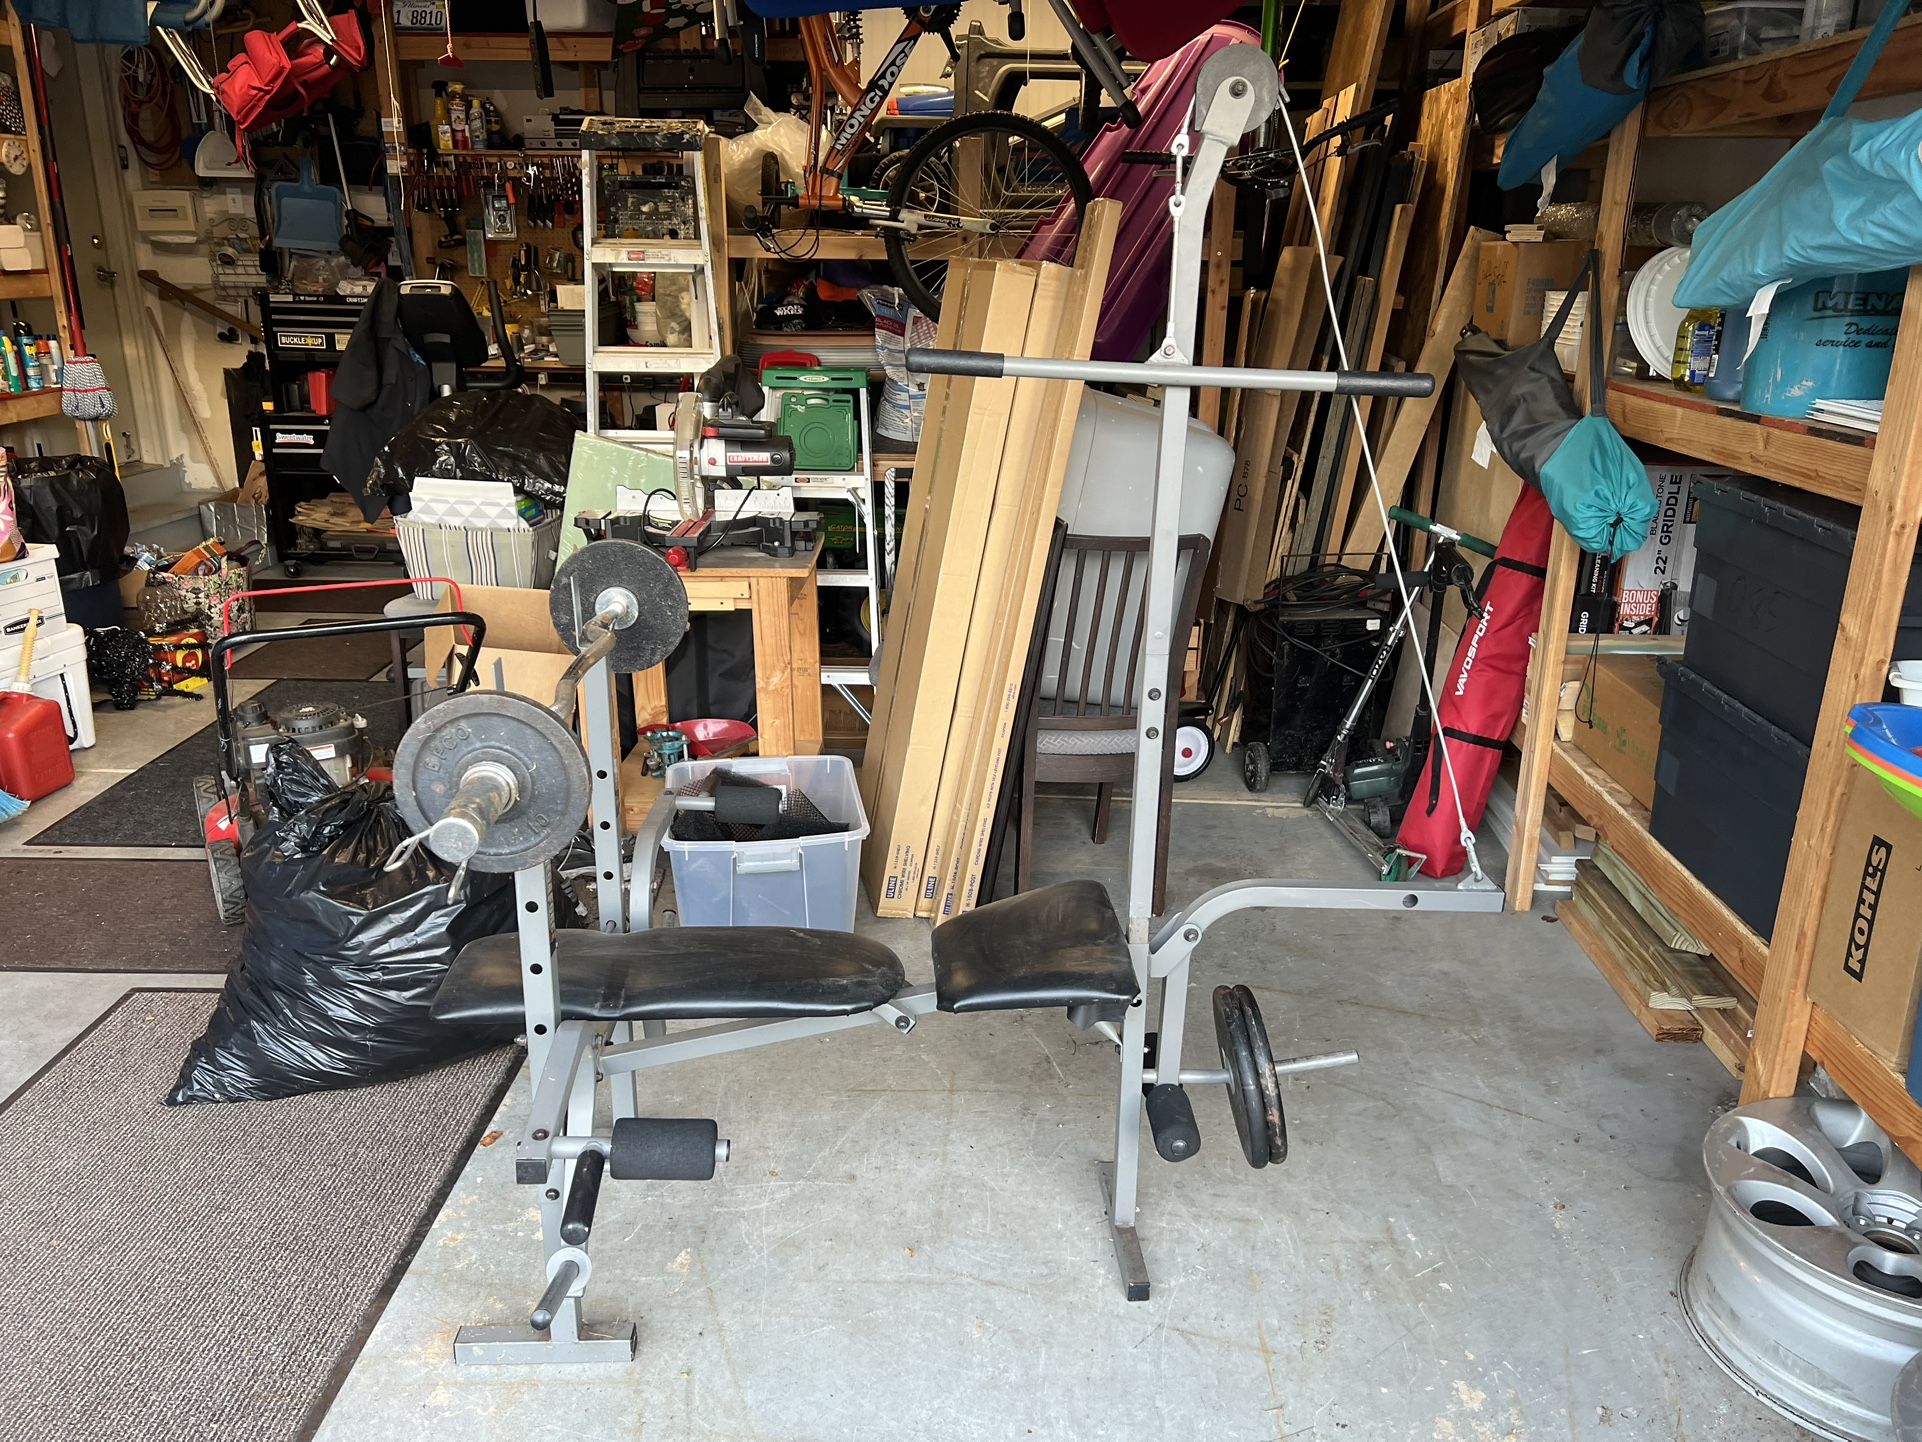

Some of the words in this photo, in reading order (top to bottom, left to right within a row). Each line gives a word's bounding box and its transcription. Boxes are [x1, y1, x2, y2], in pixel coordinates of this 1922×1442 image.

[411, 10, 443, 26] 8810
[1813, 290, 1905, 314] MENA
[281, 336, 306, 345] BUCKLE
[1816, 338, 1862, 348] service
[1865, 338, 1892, 349] and
[276, 431, 314, 442] Sweetwater
[728, 455, 769, 464] CRAFTSMAN
[1233, 483, 1249, 512] PC
[1650, 473, 1666, 536] BLATONE
[1659, 474, 1683, 546] GRIDDLE
[1622, 590, 1658, 603] BONUS
[1620, 603, 1656, 616] INSIDE!
[1455, 600, 1494, 696] VAVOSPORT
[886, 876, 898, 898] ULINE
[925, 876, 936, 898] ULINE
[1847, 844, 1887, 974] KOHL'S
